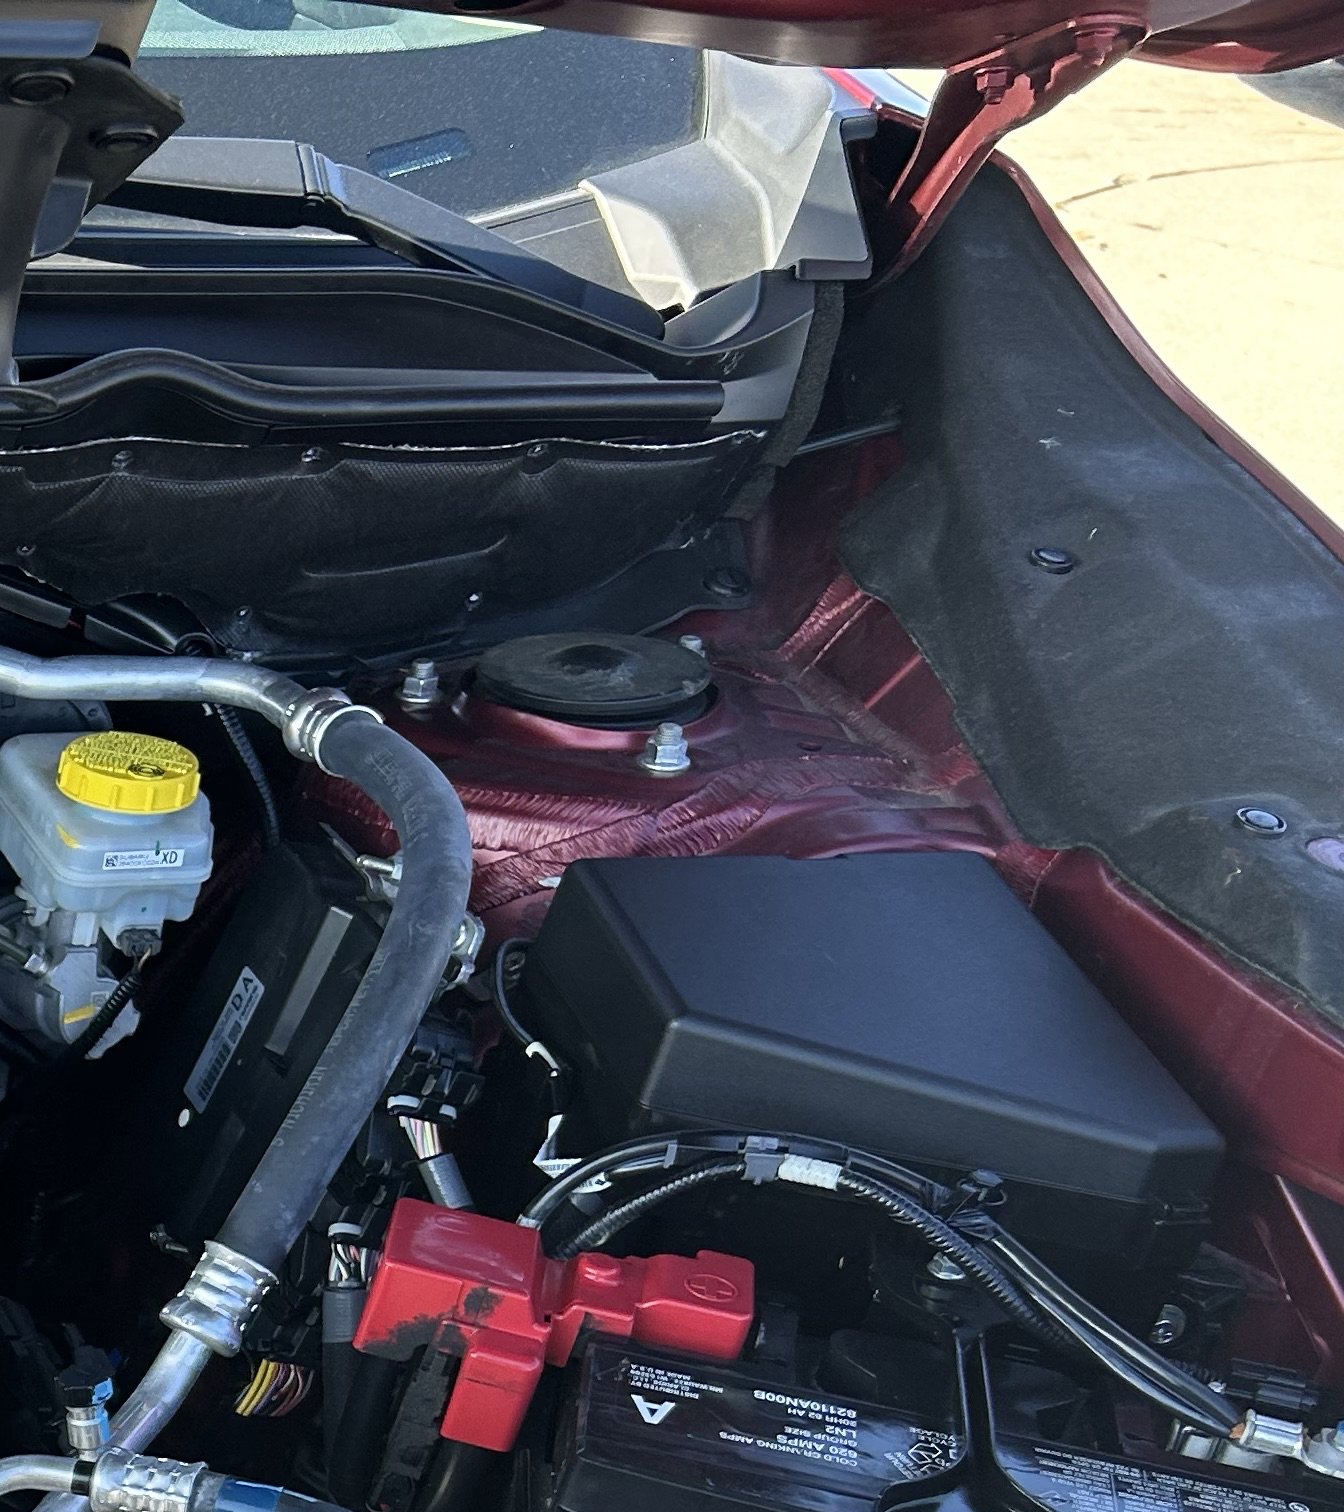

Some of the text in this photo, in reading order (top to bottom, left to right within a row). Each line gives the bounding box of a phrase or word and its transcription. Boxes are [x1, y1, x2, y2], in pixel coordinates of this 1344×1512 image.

[161, 850, 178, 865] XD
[787, 1407, 806, 1417] AH
[783, 1425, 858, 1447] GROUP SIZE
[824, 1424, 857, 1439] LN2
[718, 1430, 858, 1467] COLD CRANKING AMPS
[776, 1433, 858, 1459] 620 AMPS
